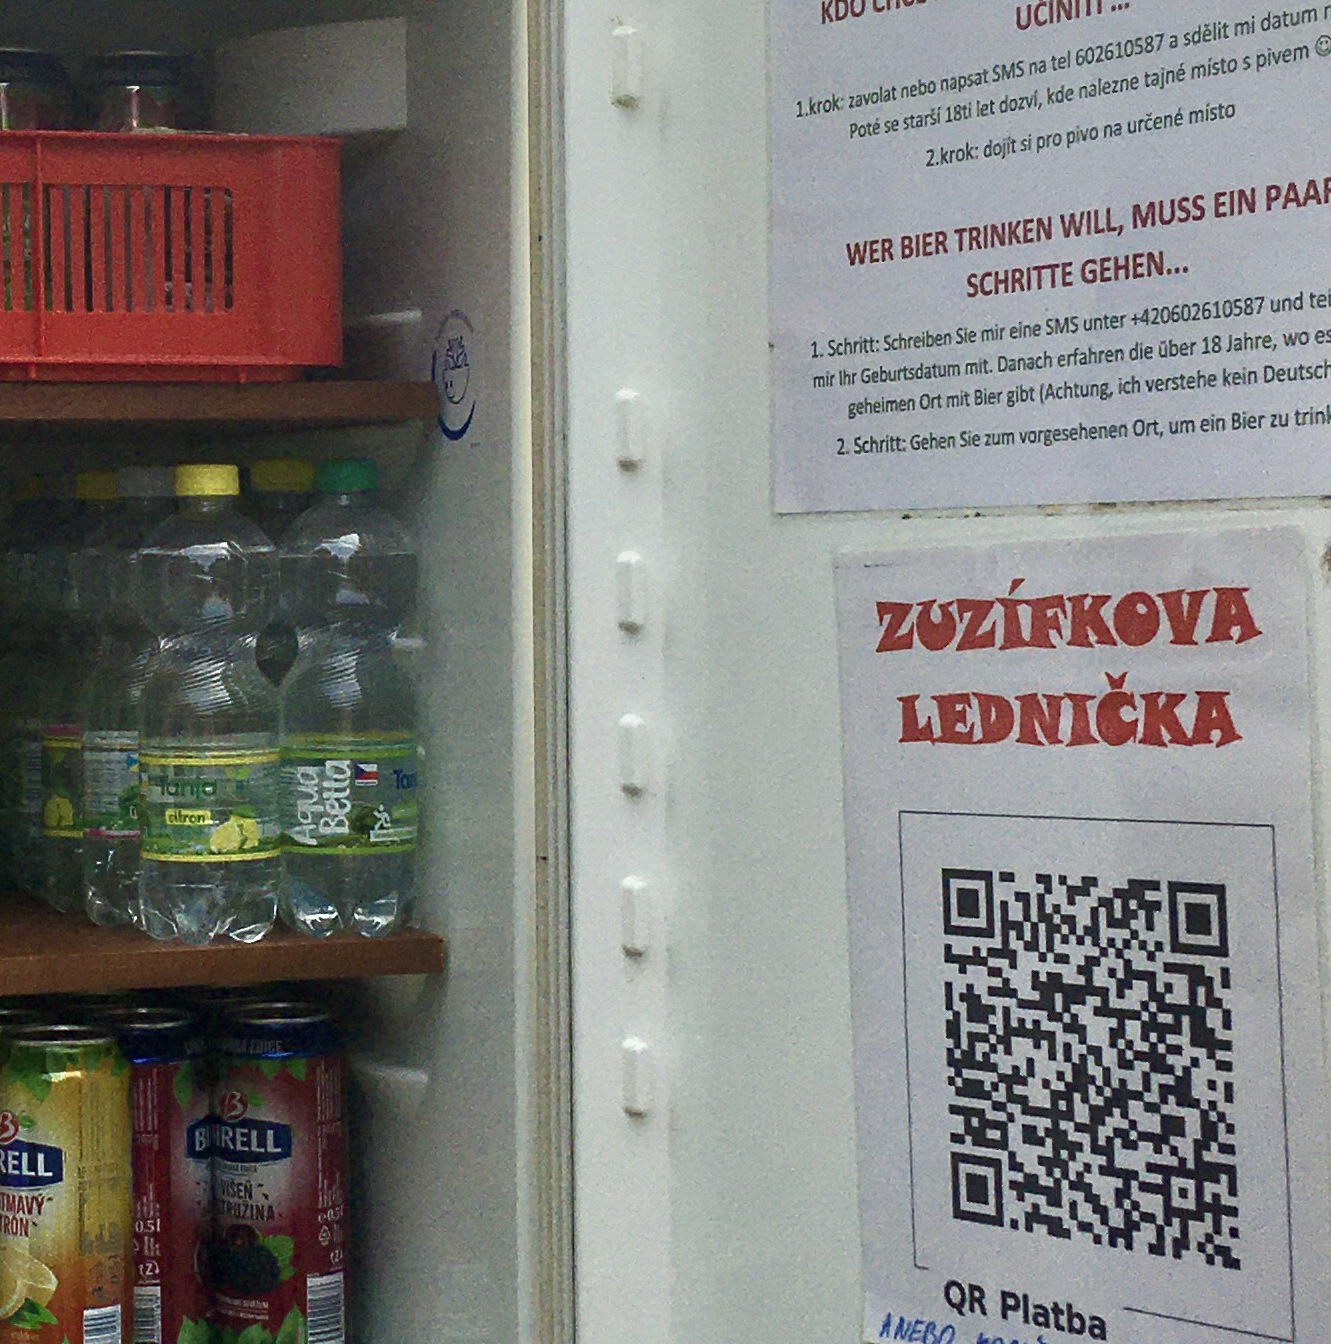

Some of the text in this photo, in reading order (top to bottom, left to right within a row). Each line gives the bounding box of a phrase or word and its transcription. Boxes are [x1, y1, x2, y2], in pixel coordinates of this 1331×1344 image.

[848, 86, 897, 109] zavolat
[901, 79, 936, 101] nebo
[940, 68, 988, 93] napsat
[992, 60, 1025, 83] SMS
[1029, 59, 1047, 75] na
[1051, 50, 1071, 71] tel
[1075, 33, 1164, 66] 602610587
[1168, 33, 1179, 49] a
[1183, 21, 1229, 47] sdělit
[1234, 15, 1255, 36] mi
[1260, 7, 1318, 32] datum
[849, 43, 1309, 139] Poté se starší 18ti let dozví, kde nalezne tajné místo s pivem
[983, 135, 1016, 161] dojít
[1020, 134, 1032, 152] si
[1036, 131, 1062, 153] pro
[1066, 124, 1099, 148] pivo
[1103, 121, 1123, 138] na
[1127, 109, 1184, 135] určené
[1188, 102, 1236, 125] místo
[846, 238, 894, 267] WER
[900, 231, 949, 260] BIER
[954, 216, 1052, 252] TRINKEN
[1059, 207, 1124, 239] WILL,
[1132, 194, 1206, 230] MUSS
[1213, 186, 1256, 219] EIN
[966, 261, 1073, 298] SCHRITTE
[810, 341, 824, 359] 1.
[828, 337, 880, 358] Schritt:
[883, 330, 952, 352] Schreiben
[956, 327, 977, 345] Sie
[981, 324, 1006, 342] mir
[1009, 322, 1042, 340] eine
[1045, 316, 1079, 336] SMS
[1083, 313, 1127, 332] unter
[1131, 296, 1265, 327] +420602610587
[1270, 291, 1304, 312] und
[813, 370, 835, 389] mir
[860, 362, 960, 384] Geburtsdatum
[965, 357, 993, 376] mit.
[997, 350, 1053, 374] Danach
[1057, 346, 1124, 369] erfahren
[1128, 341, 1154, 362] die
[1158, 339, 1197, 358] über
[1201, 335, 1222, 355] 18
[1226, 332, 1278, 354] Jahre,
[1282, 330, 1310, 348] wo
[847, 396, 916, 420] geheimen
[919, 393, 943, 410] Ort
[946, 389, 971, 408] mit
[974, 387, 1003, 406] Bier
[1006, 385, 1036, 408] gibt
[1039, 378, 1114, 404] (Achtung,
[1118, 376, 1141, 396] ich
[1145, 370, 1217, 393] verstehe
[1222, 367, 1257, 387] kein
[836, 437, 851, 456] 2.
[853, 434, 907, 456] Schritt:
[910, 432, 956, 452] Gehen
[959, 430, 981, 447] Sie
[984, 430, 1015, 447] zum
[1019, 421, 1128, 447] vorgesehenen
[1132, 418, 1164, 438] Ort,
[1169, 418, 1196, 435] um
[1200, 414, 1226, 433] ein
[1231, 411, 1266, 431] Bier
[1270, 411, 1289, 428] zu
[875, 578, 1263, 653] ZUZÍFKOVA
[896, 671, 1243, 748] LEDNIČKA
[289, 766, 325, 846] Aqua
[319, 760, 351, 834] Betta
[943, 1279, 1108, 1342] QR Platba
